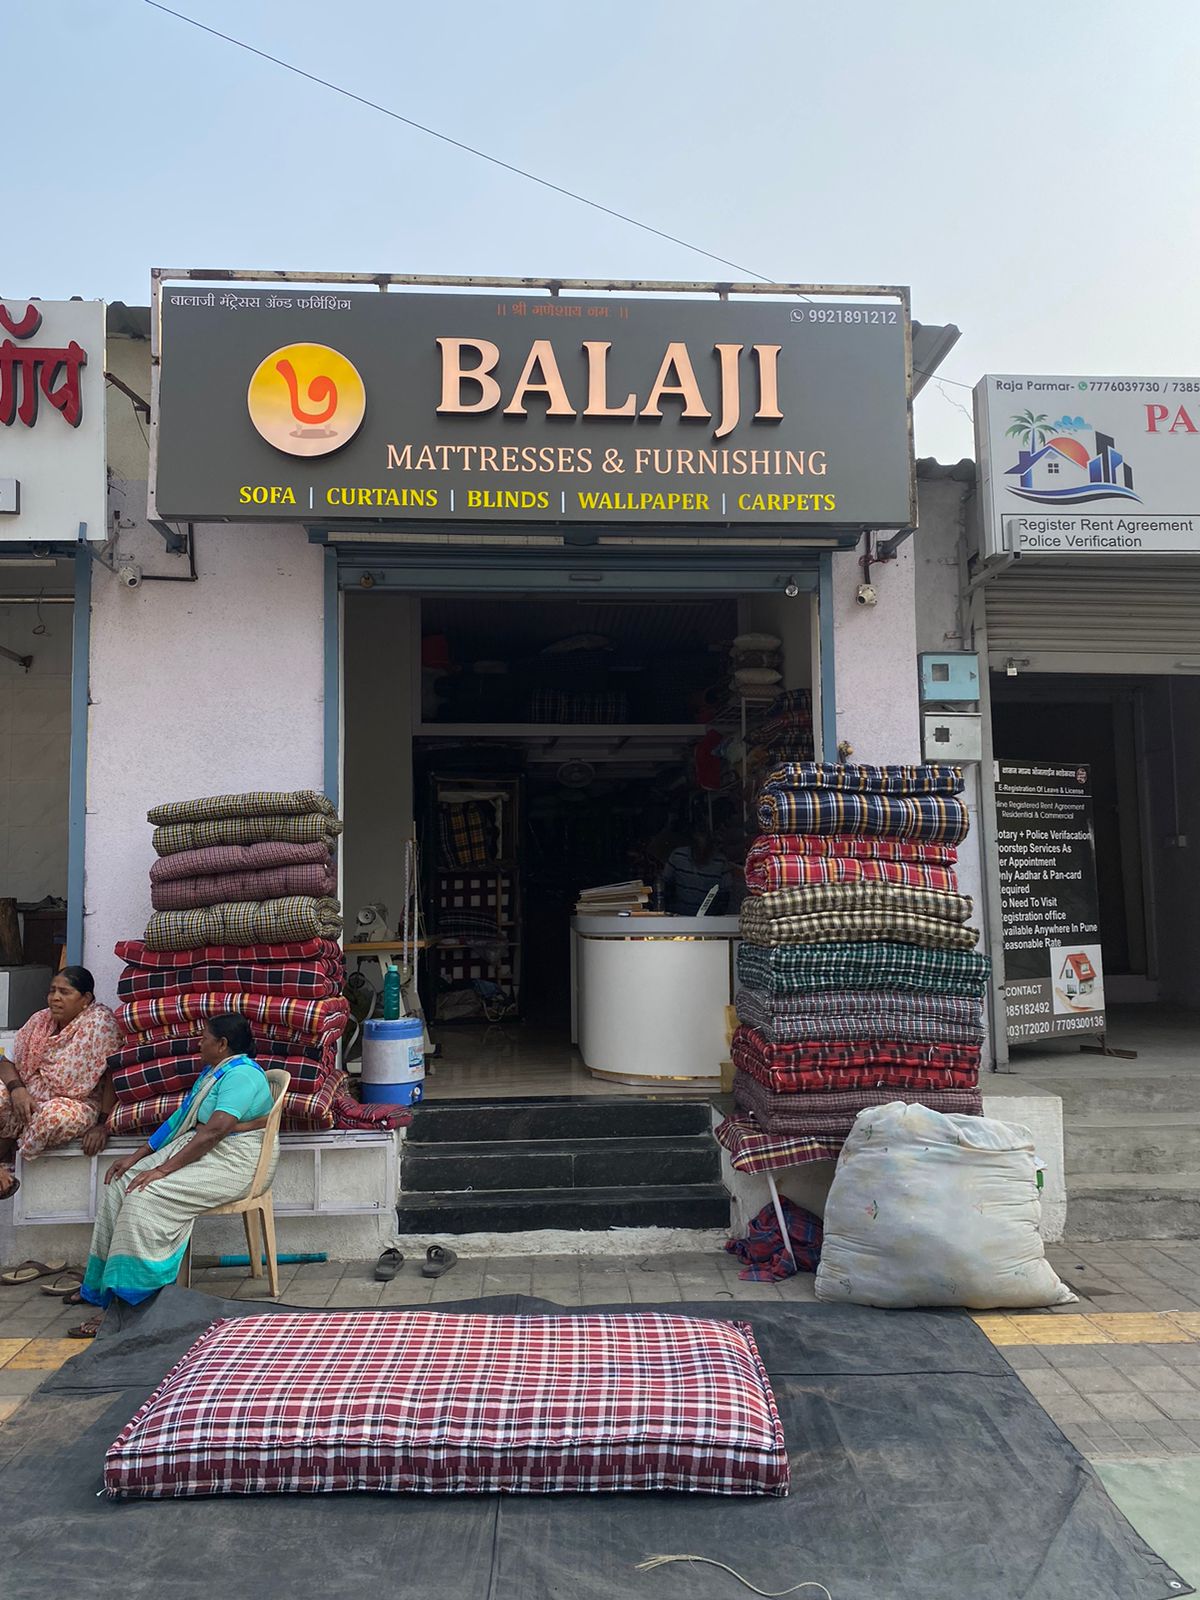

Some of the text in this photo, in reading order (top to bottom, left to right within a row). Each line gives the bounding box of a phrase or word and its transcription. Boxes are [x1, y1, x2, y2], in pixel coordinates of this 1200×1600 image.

[511, 301, 527, 317] श्री
[809, 309, 897, 324] 9921891212
[435, 336, 785, 439] BALAJI
[996, 380, 1023, 393] Raja
[1089, 381, 1160, 392] 7776039730
[1172, 382, 1200, 393] 7385
[1143, 403, 1200, 434] PA
[386, 443, 828, 477] MATTRESSES & FURNISHING
[239, 485, 837, 512] SOFA CURTAINS BLINDS WALLPAPER CARPETS
[1018, 518, 1193, 533] Register Rent Agreement
[1019, 534, 1142, 547] Police Verification
[998, 783, 1036, 793] E-Registration
[1008, 800, 1040, 810] Registered
[1054, 803, 1085, 811] Agreement
[1002, 810, 1033, 819] Residential
[1040, 811, 1074, 820] Commercial
[998, 830, 1018, 841] otary
[1025, 829, 1049, 839] Police
[999, 842, 1072, 855] oorstep Services As
[999, 856, 1057, 868] er Appointment
[1000, 869, 1082, 882] nly Aadhar & Pan-card
[1001, 883, 1030, 896] equired
[1002, 896, 1058, 908] o Need To Visit
[1044, 910, 1067, 920] office
[1034, 923, 1071, 936] Anywhere
[1071, 923, 1079, 933] In
[1079, 922, 1098, 933] Pune
[1003, 937, 1062, 950] easonable Rate
[1005, 984, 1042, 997] CONTACT
[1006, 1020, 1050, 1037] 03172020
[1056, 1015, 1104, 1031] 7709300136
